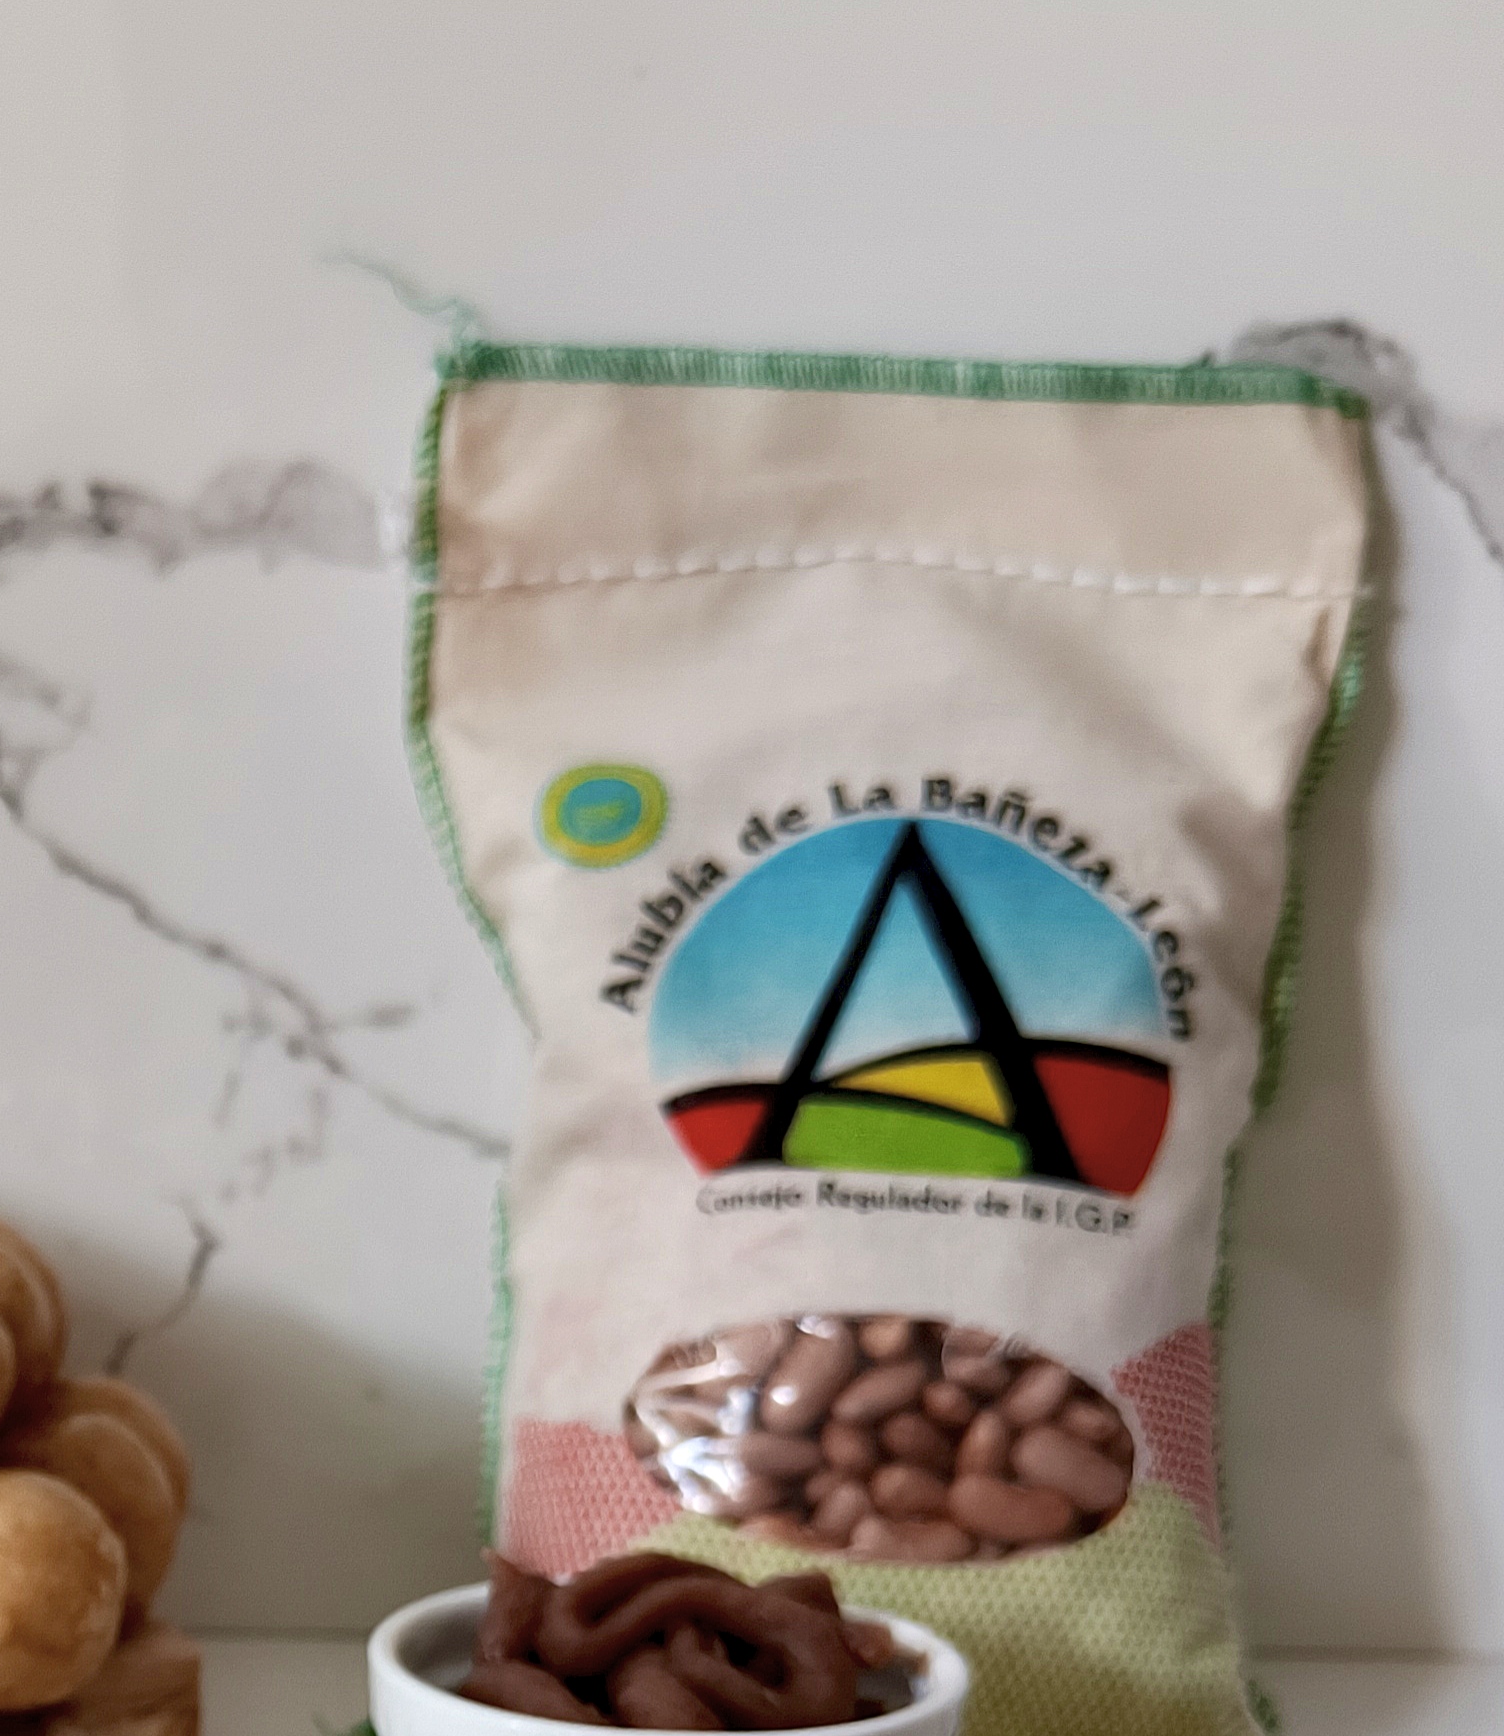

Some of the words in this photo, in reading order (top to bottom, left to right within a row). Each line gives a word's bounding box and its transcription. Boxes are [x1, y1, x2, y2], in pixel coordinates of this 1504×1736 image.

[600, 863, 727, 1014] Alubia
[739, 802, 808, 854] de
[831, 783, 897, 817] La
[816, 1178, 961, 1214] Regulador
[974, 1189, 1010, 1217] de
[1022, 1191, 1047, 1222] la
